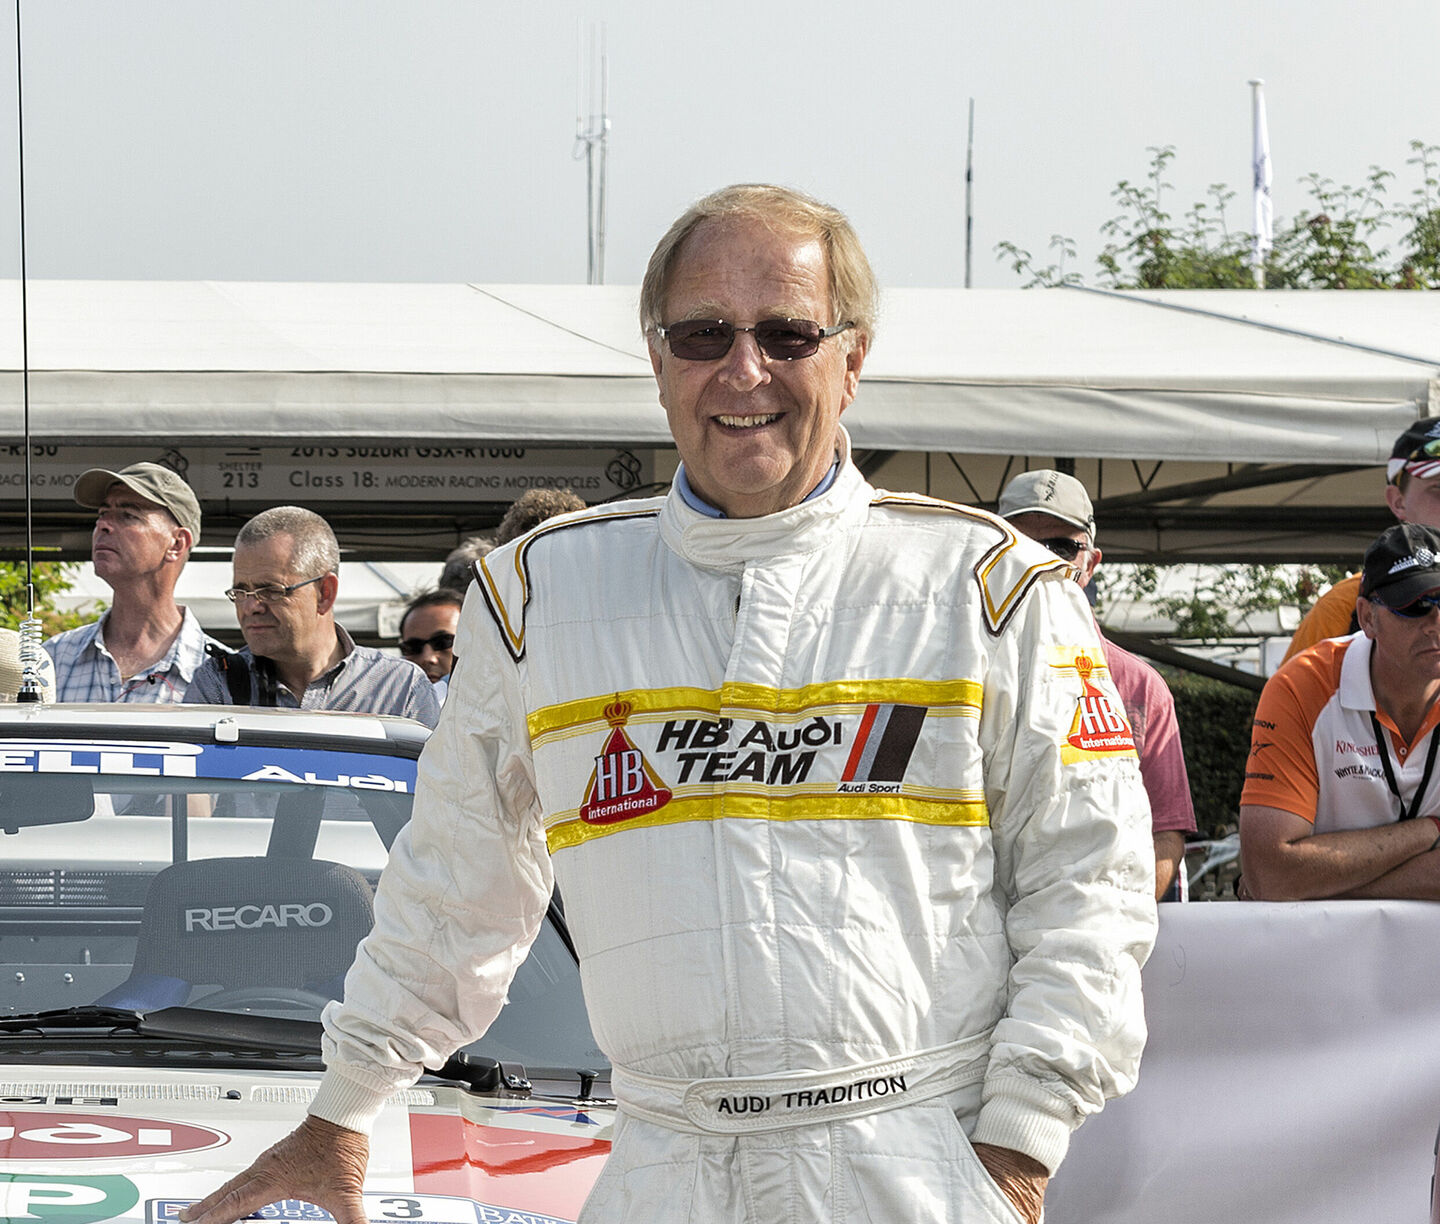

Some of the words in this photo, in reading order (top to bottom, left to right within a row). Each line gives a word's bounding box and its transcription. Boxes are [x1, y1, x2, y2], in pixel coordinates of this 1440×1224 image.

[223, 473, 259, 488] 213
[289, 470, 344, 488] Class
[352, 471, 379, 488] 18:
[385, 475, 446, 488] MODERN
[449, 476, 500, 489] RACING
[504, 476, 600, 489] MOTORCYCLES
[1077, 696, 1125, 734] HB
[656, 719, 733, 753] HB
[594, 750, 644, 801] HB
[676, 750, 818, 786] TEAM
[838, 783, 865, 793] Audi
[868, 783, 901, 794] Sport
[587, 795, 657, 820] international
[185, 902, 332, 932] RECARO
[718, 1096, 770, 1114] AUDI
[782, 1076, 908, 1108] TRADITION
[380, 1198, 423, 1219] 3
